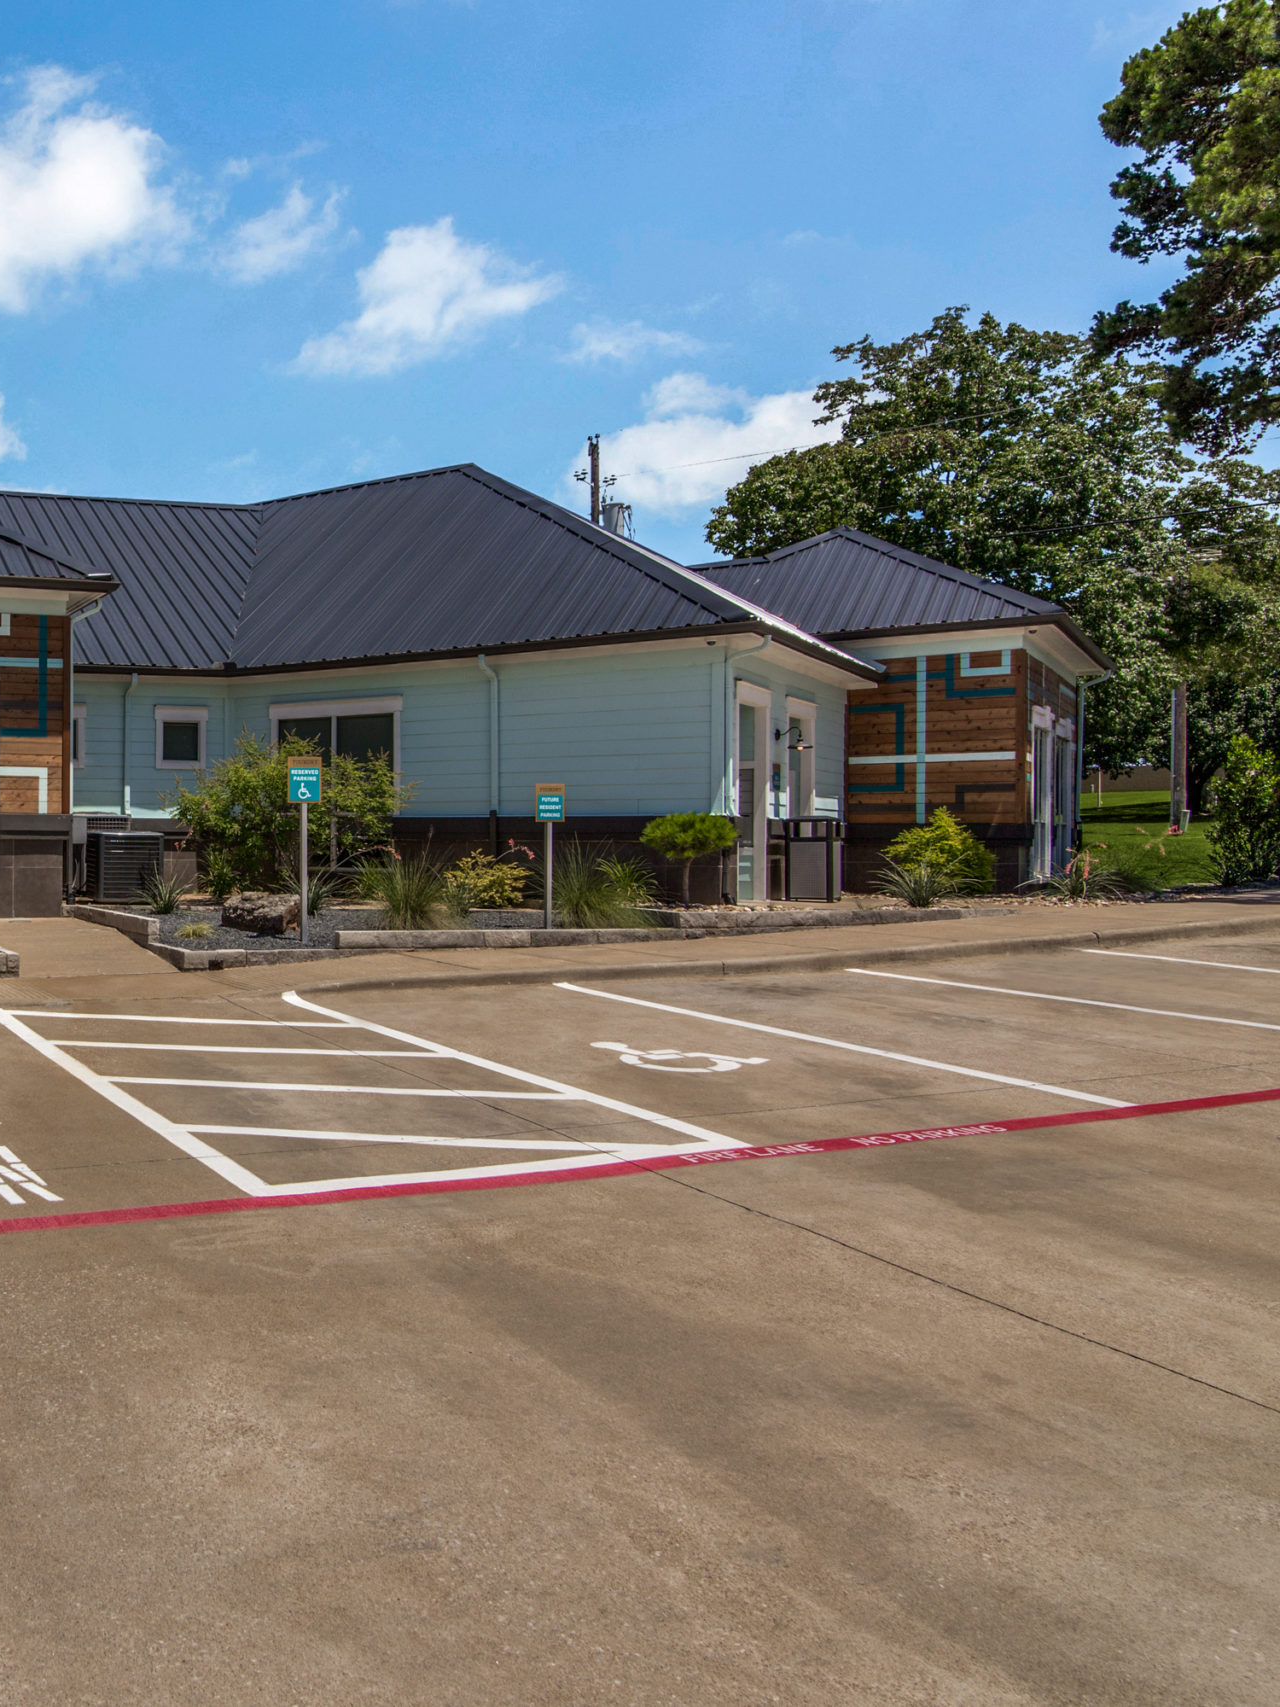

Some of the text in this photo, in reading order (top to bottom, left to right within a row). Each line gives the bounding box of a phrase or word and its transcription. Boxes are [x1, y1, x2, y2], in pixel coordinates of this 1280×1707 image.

[849, 1124, 1008, 1146] NO PARKING
[679, 1143, 825, 1164] FIRE LANE
